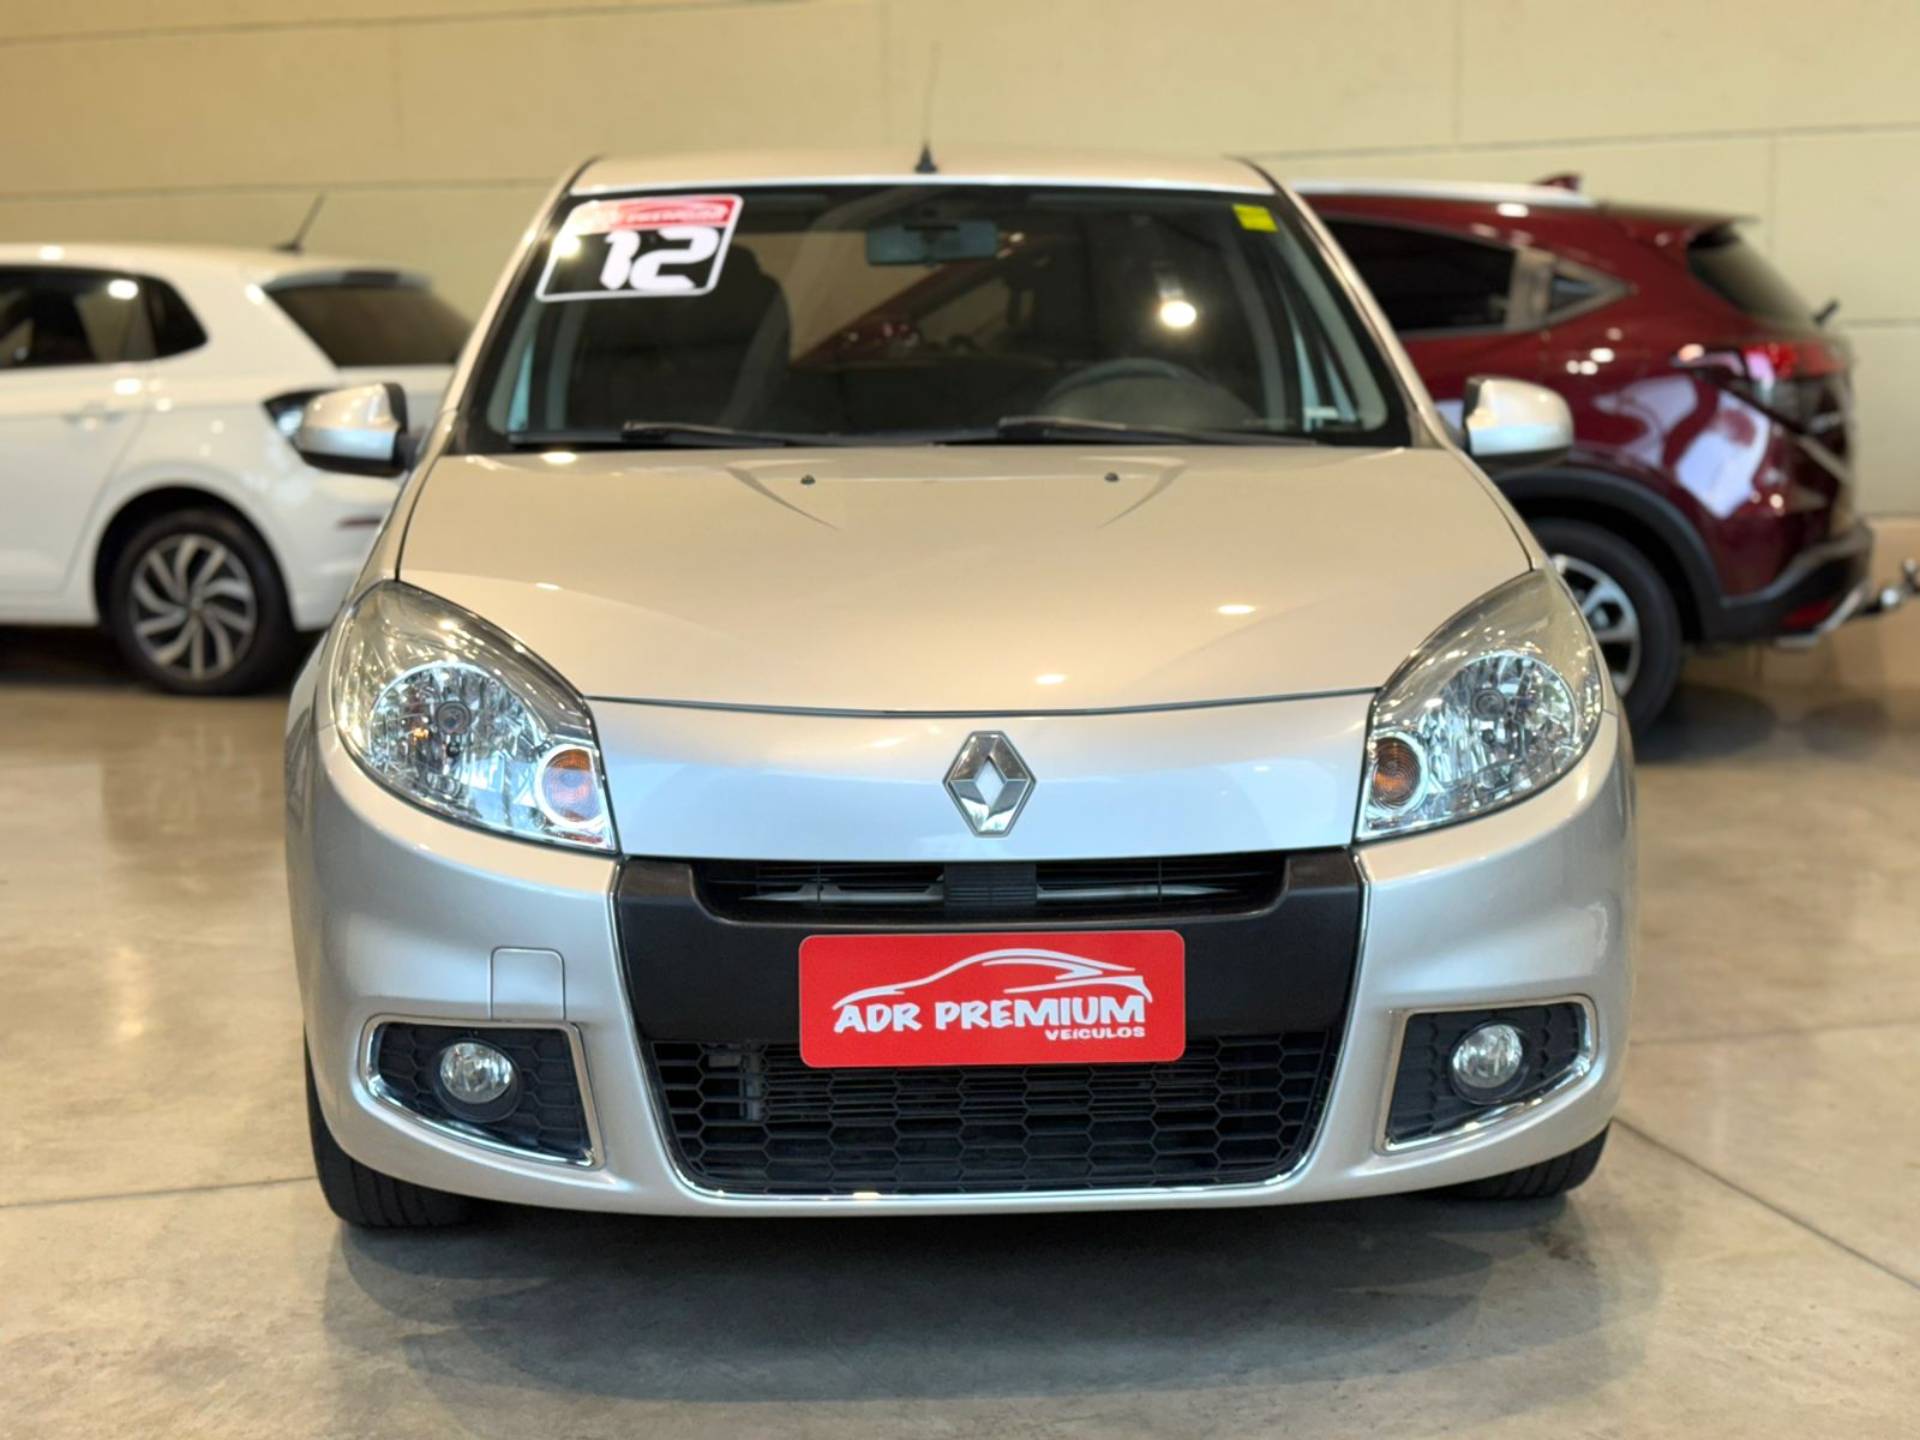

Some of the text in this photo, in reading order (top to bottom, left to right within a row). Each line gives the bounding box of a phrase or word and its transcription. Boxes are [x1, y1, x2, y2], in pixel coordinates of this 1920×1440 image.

[600, 226, 720, 290] 12
[834, 995, 1146, 1033] ADR PREMIUM
